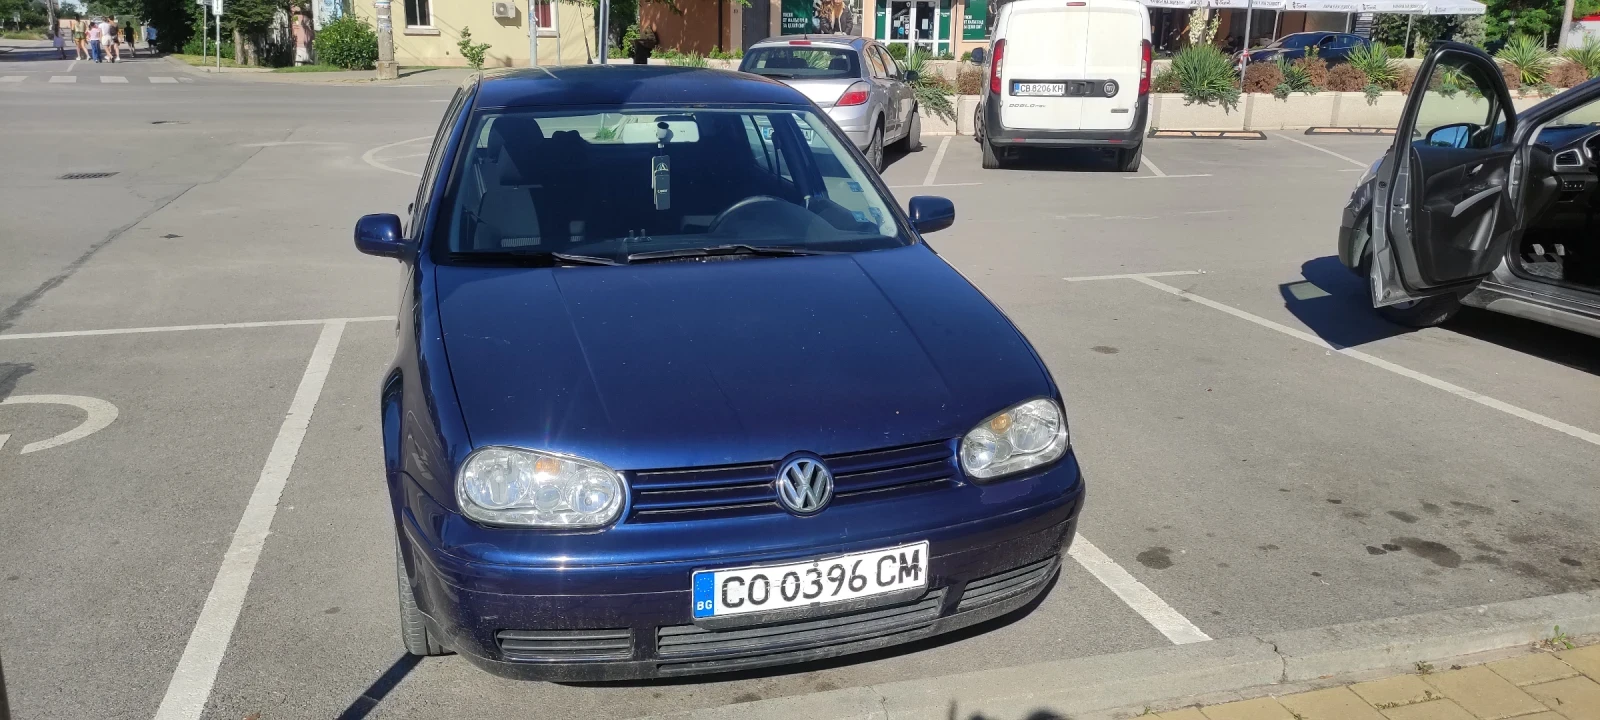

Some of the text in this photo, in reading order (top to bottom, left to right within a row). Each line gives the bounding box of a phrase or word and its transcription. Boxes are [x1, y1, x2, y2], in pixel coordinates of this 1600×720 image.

[1020, 84, 1064, 93] CB 8206 KH
[721, 549, 921, 609] CO 0396 CM
[696, 599, 713, 611] BG
